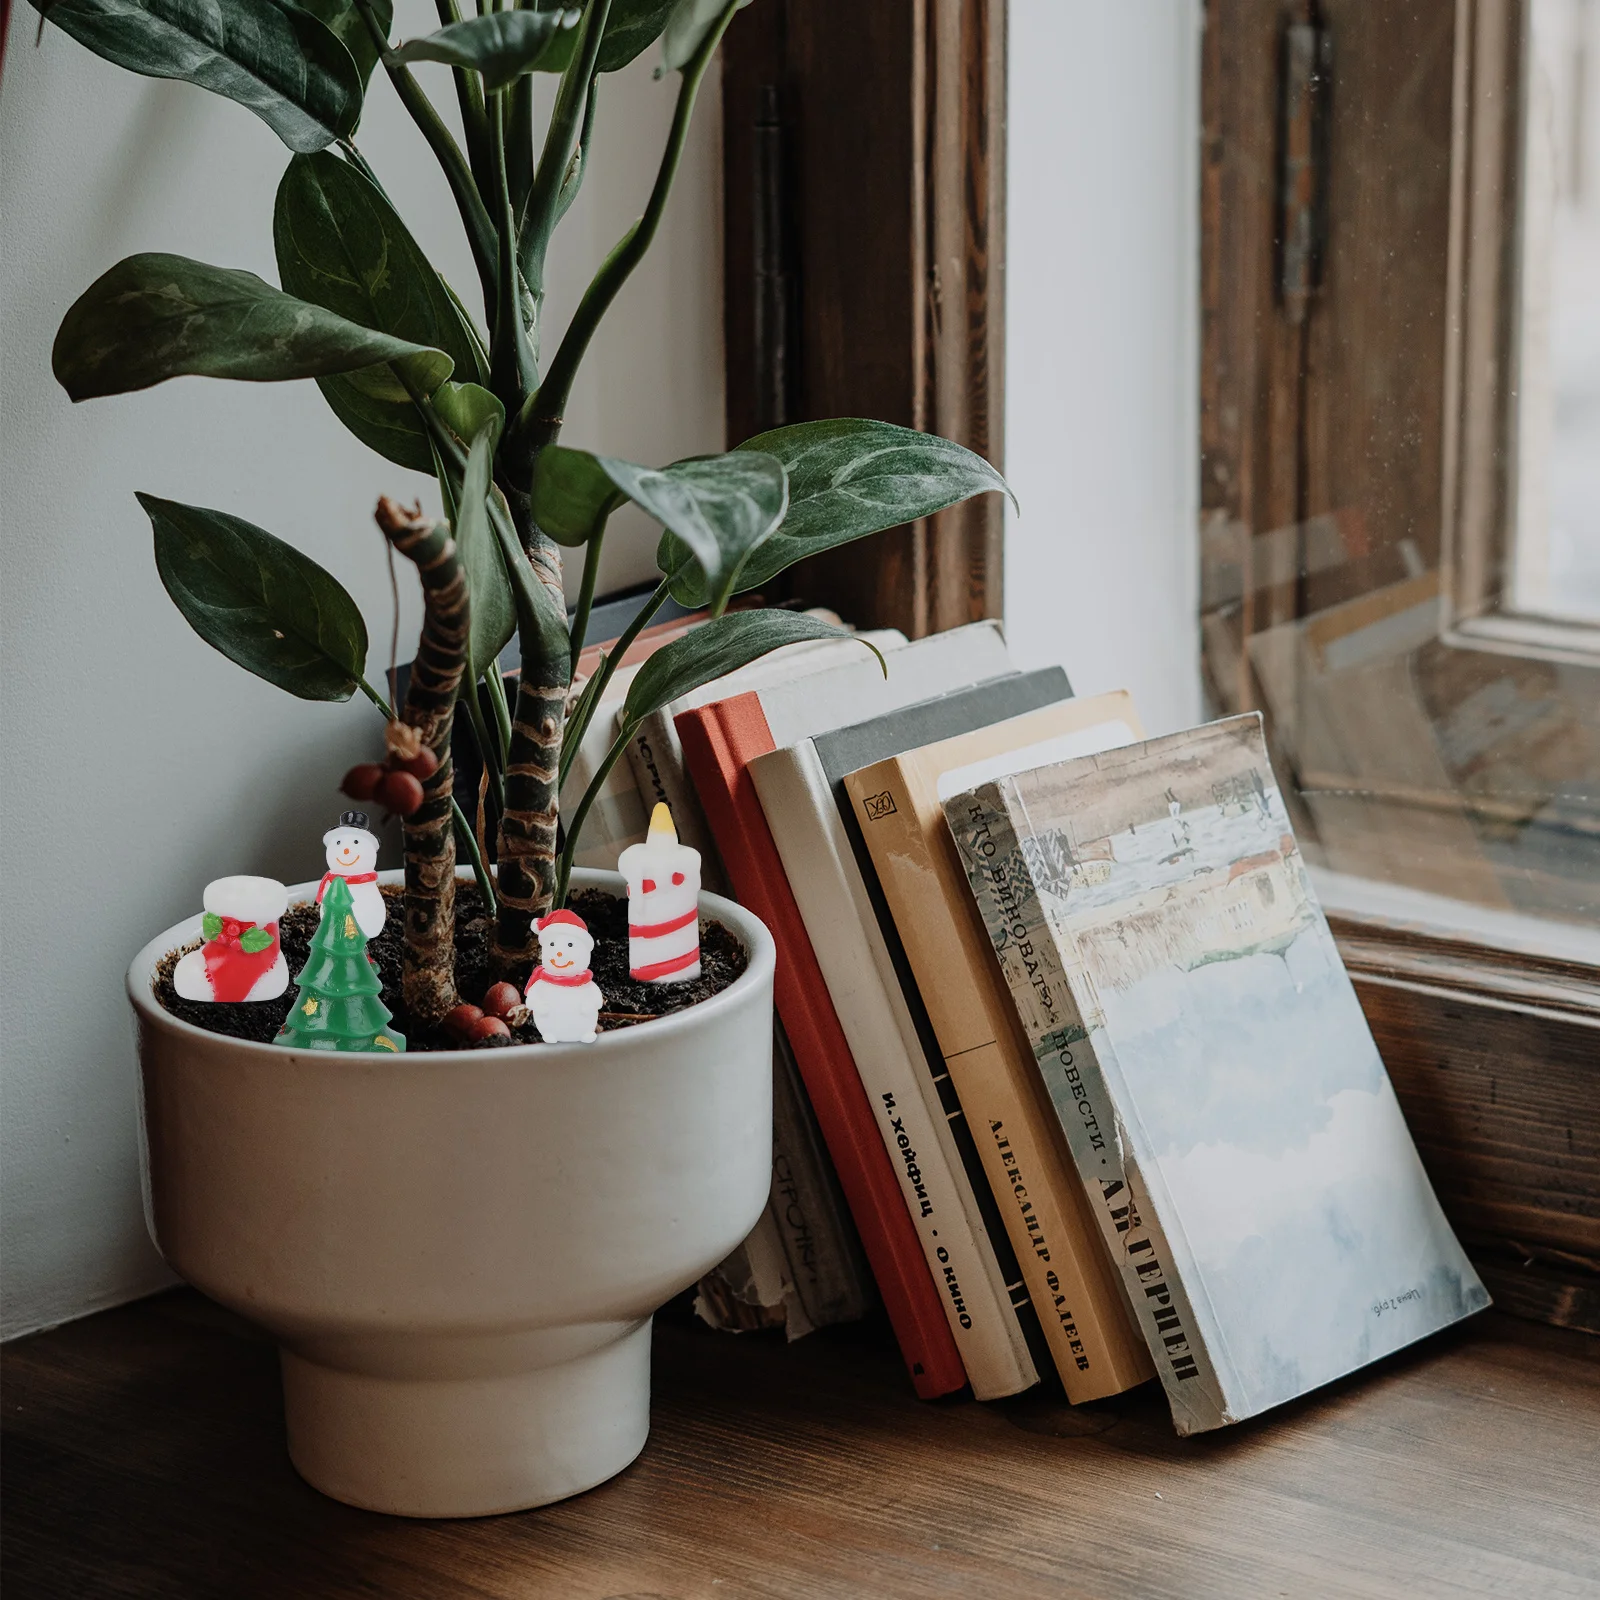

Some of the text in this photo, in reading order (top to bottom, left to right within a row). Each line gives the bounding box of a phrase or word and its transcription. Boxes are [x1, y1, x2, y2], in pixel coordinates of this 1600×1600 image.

[968, 804, 996, 858] КТО
[1052, 1031, 1106, 1151] ПОВЕСТИ
[1127, 1238, 1200, 1382] ГЕРЦЕН
[988, 1119, 1090, 1372] АЛЕКСАНДР ФАДЕЕВ
[1390, 1299, 1398, 1310] 2
[1396, 1289, 1421, 1304] Цена
